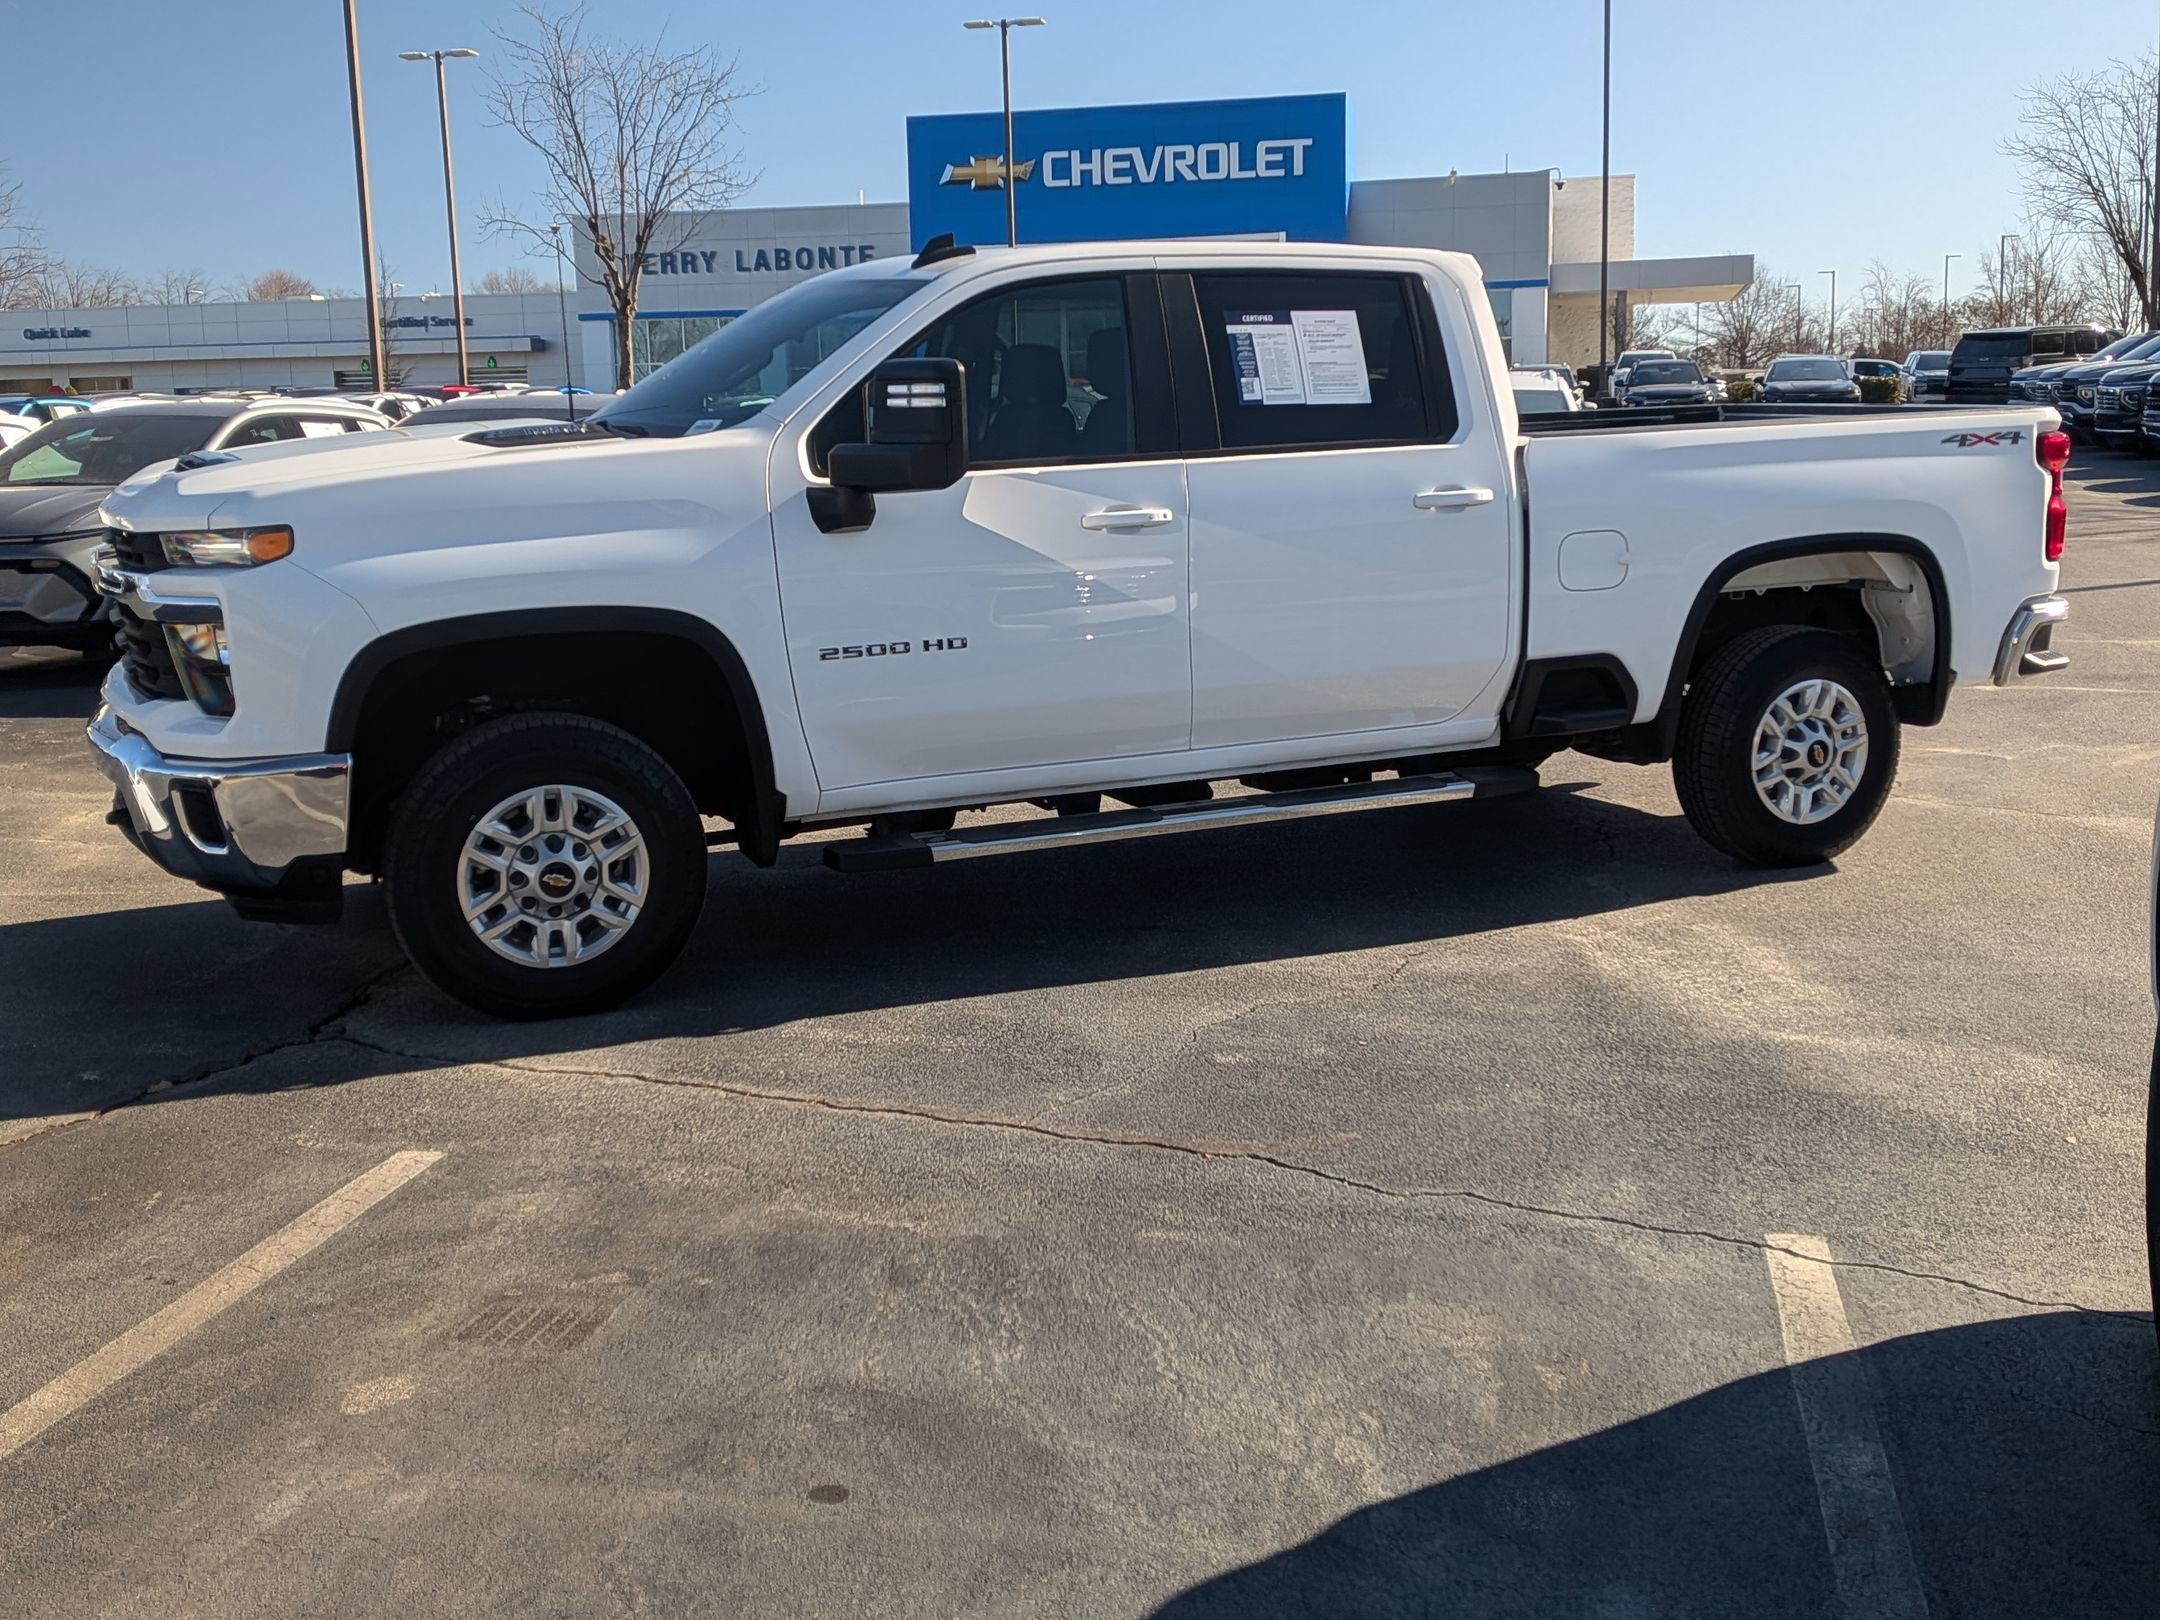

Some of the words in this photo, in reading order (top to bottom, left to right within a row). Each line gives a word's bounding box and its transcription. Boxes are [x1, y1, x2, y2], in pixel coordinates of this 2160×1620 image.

[1042, 138, 1313, 187] CHEVROLET
[736, 245, 875, 273] LABONTE
[430, 315, 473, 326] Serve
[1242, 314, 1274, 322] CERTIFIED
[23, 328, 60, 340] Quick
[60, 327, 92, 338] Lube
[819, 641, 911, 661] 2500
[922, 636, 968, 652] HD
